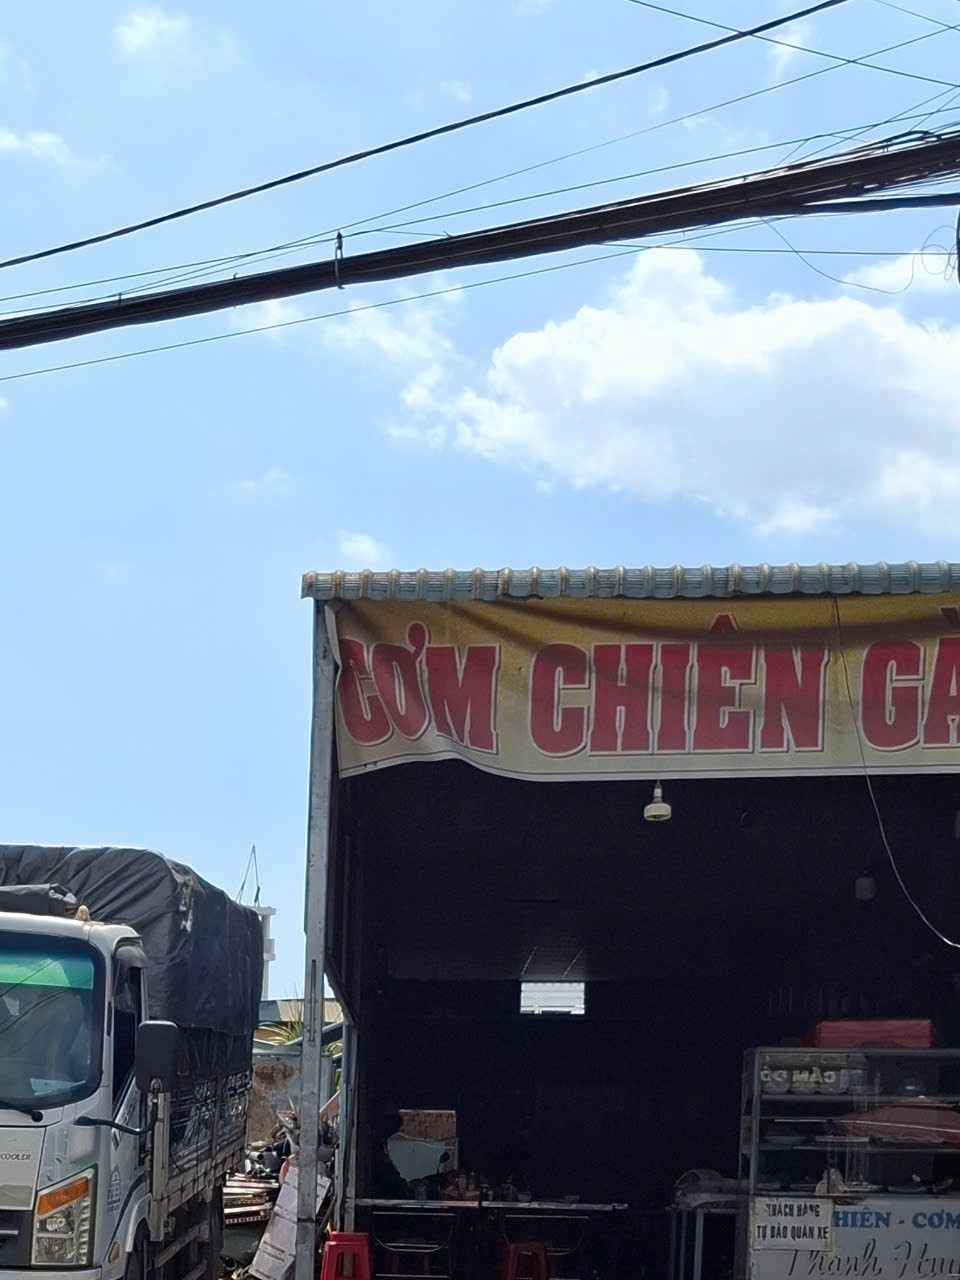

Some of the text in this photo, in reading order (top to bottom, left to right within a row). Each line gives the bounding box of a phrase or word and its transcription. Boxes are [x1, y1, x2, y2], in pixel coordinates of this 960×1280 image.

[340, 621, 499, 754] CƠM
[530, 612, 830, 756] CHIÊN
[832, 1207, 892, 1229] HIÊN
[817, 1225, 829, 1240] XE
